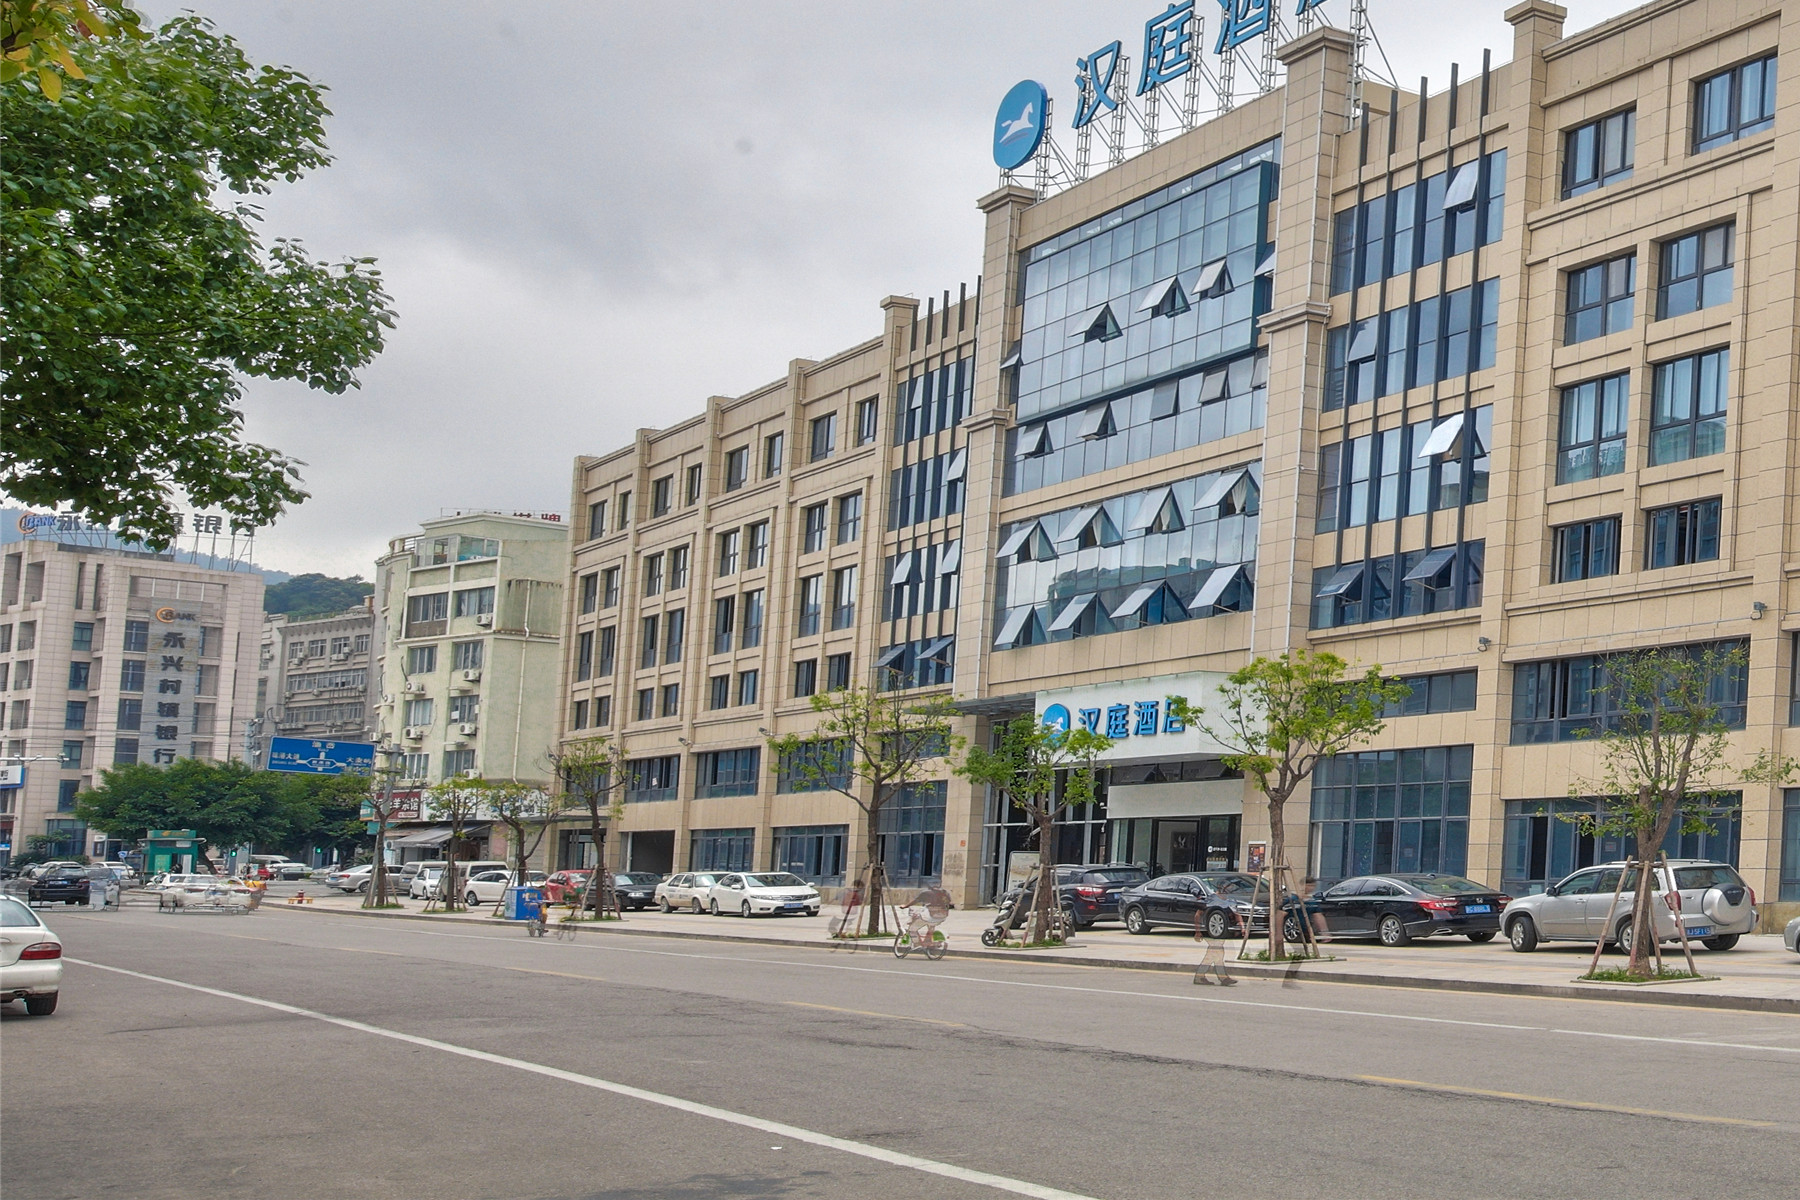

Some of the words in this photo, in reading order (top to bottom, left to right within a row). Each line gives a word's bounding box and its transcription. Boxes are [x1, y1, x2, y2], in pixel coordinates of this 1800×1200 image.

[154, 631, 186, 764] 永兴村镇银行
[1078, 695, 1188, 739] 汉庭酒店
